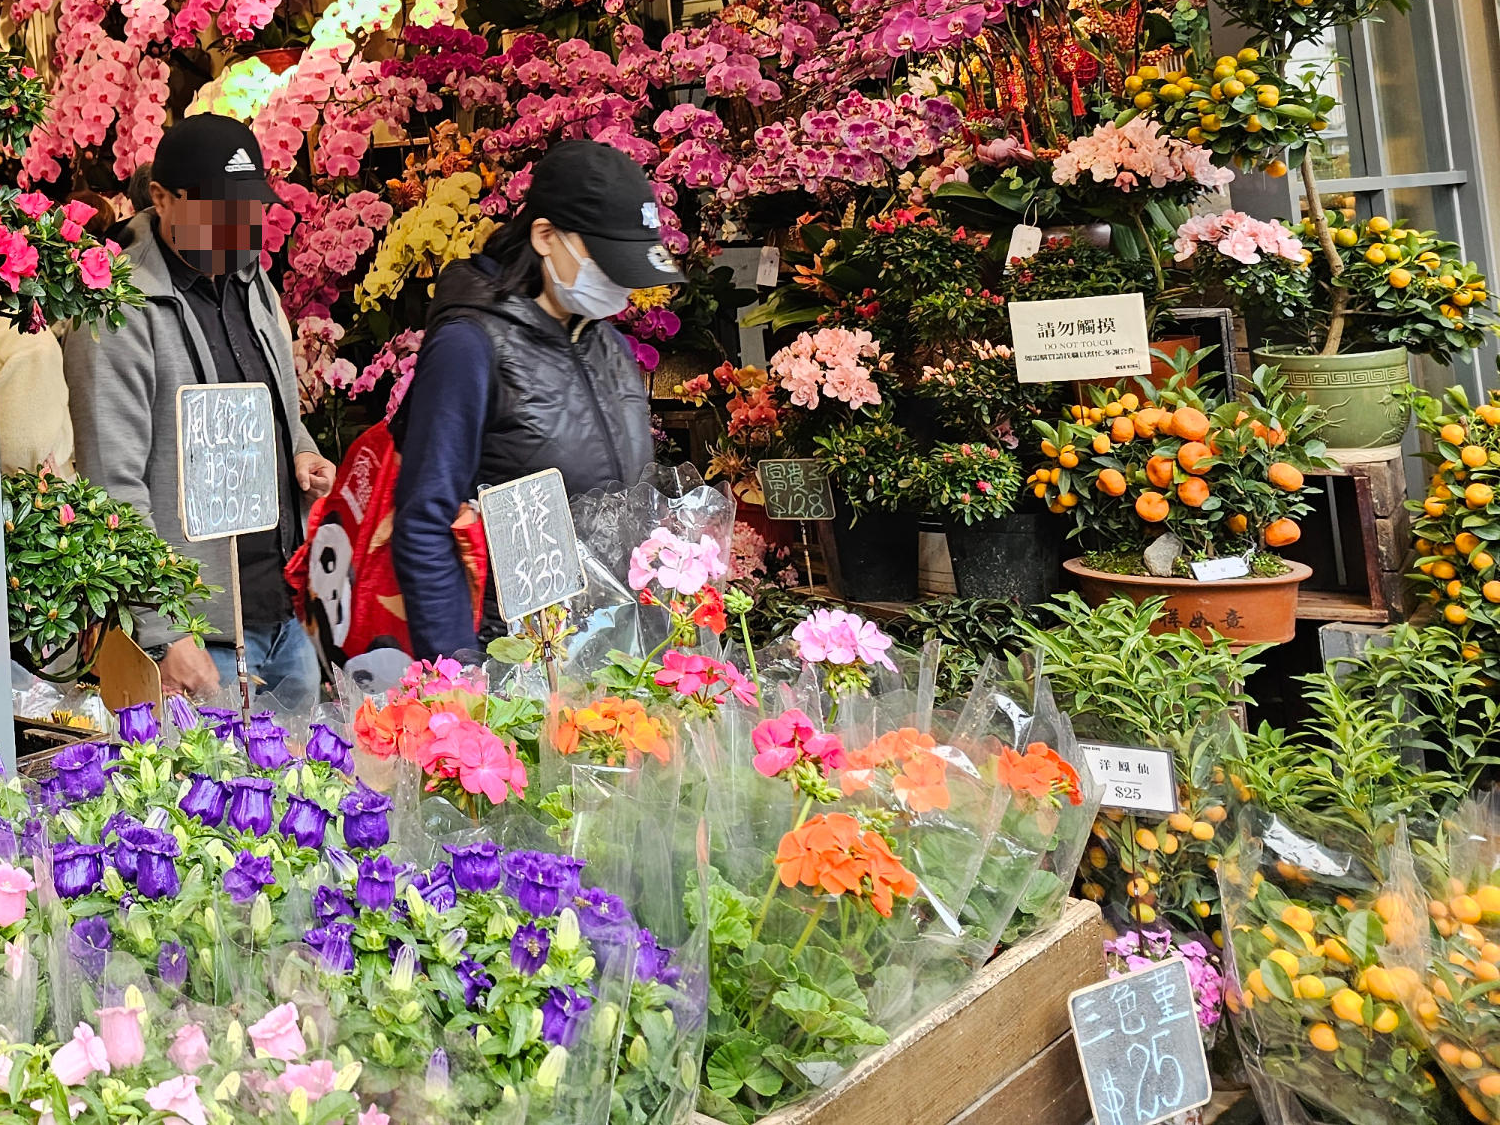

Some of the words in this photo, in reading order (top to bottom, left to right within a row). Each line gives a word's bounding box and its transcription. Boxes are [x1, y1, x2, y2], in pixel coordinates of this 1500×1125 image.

[1036, 317, 1117, 339] 請勿觸摸
[1044, 343, 1057, 351] DO
[1060, 341, 1079, 349] NOT
[1080, 339, 1113, 348] TOUCH
[185, 390, 265, 451] 風鈴花
[768, 490, 827, 519] $128
[514, 548, 566, 606] $38
[1099, 758, 1150, 775] 洋鳳仙
[1114, 785, 1142, 801] $25
[1078, 966, 1190, 1048] 三色堇
[1100, 1029, 1185, 1125] $25
